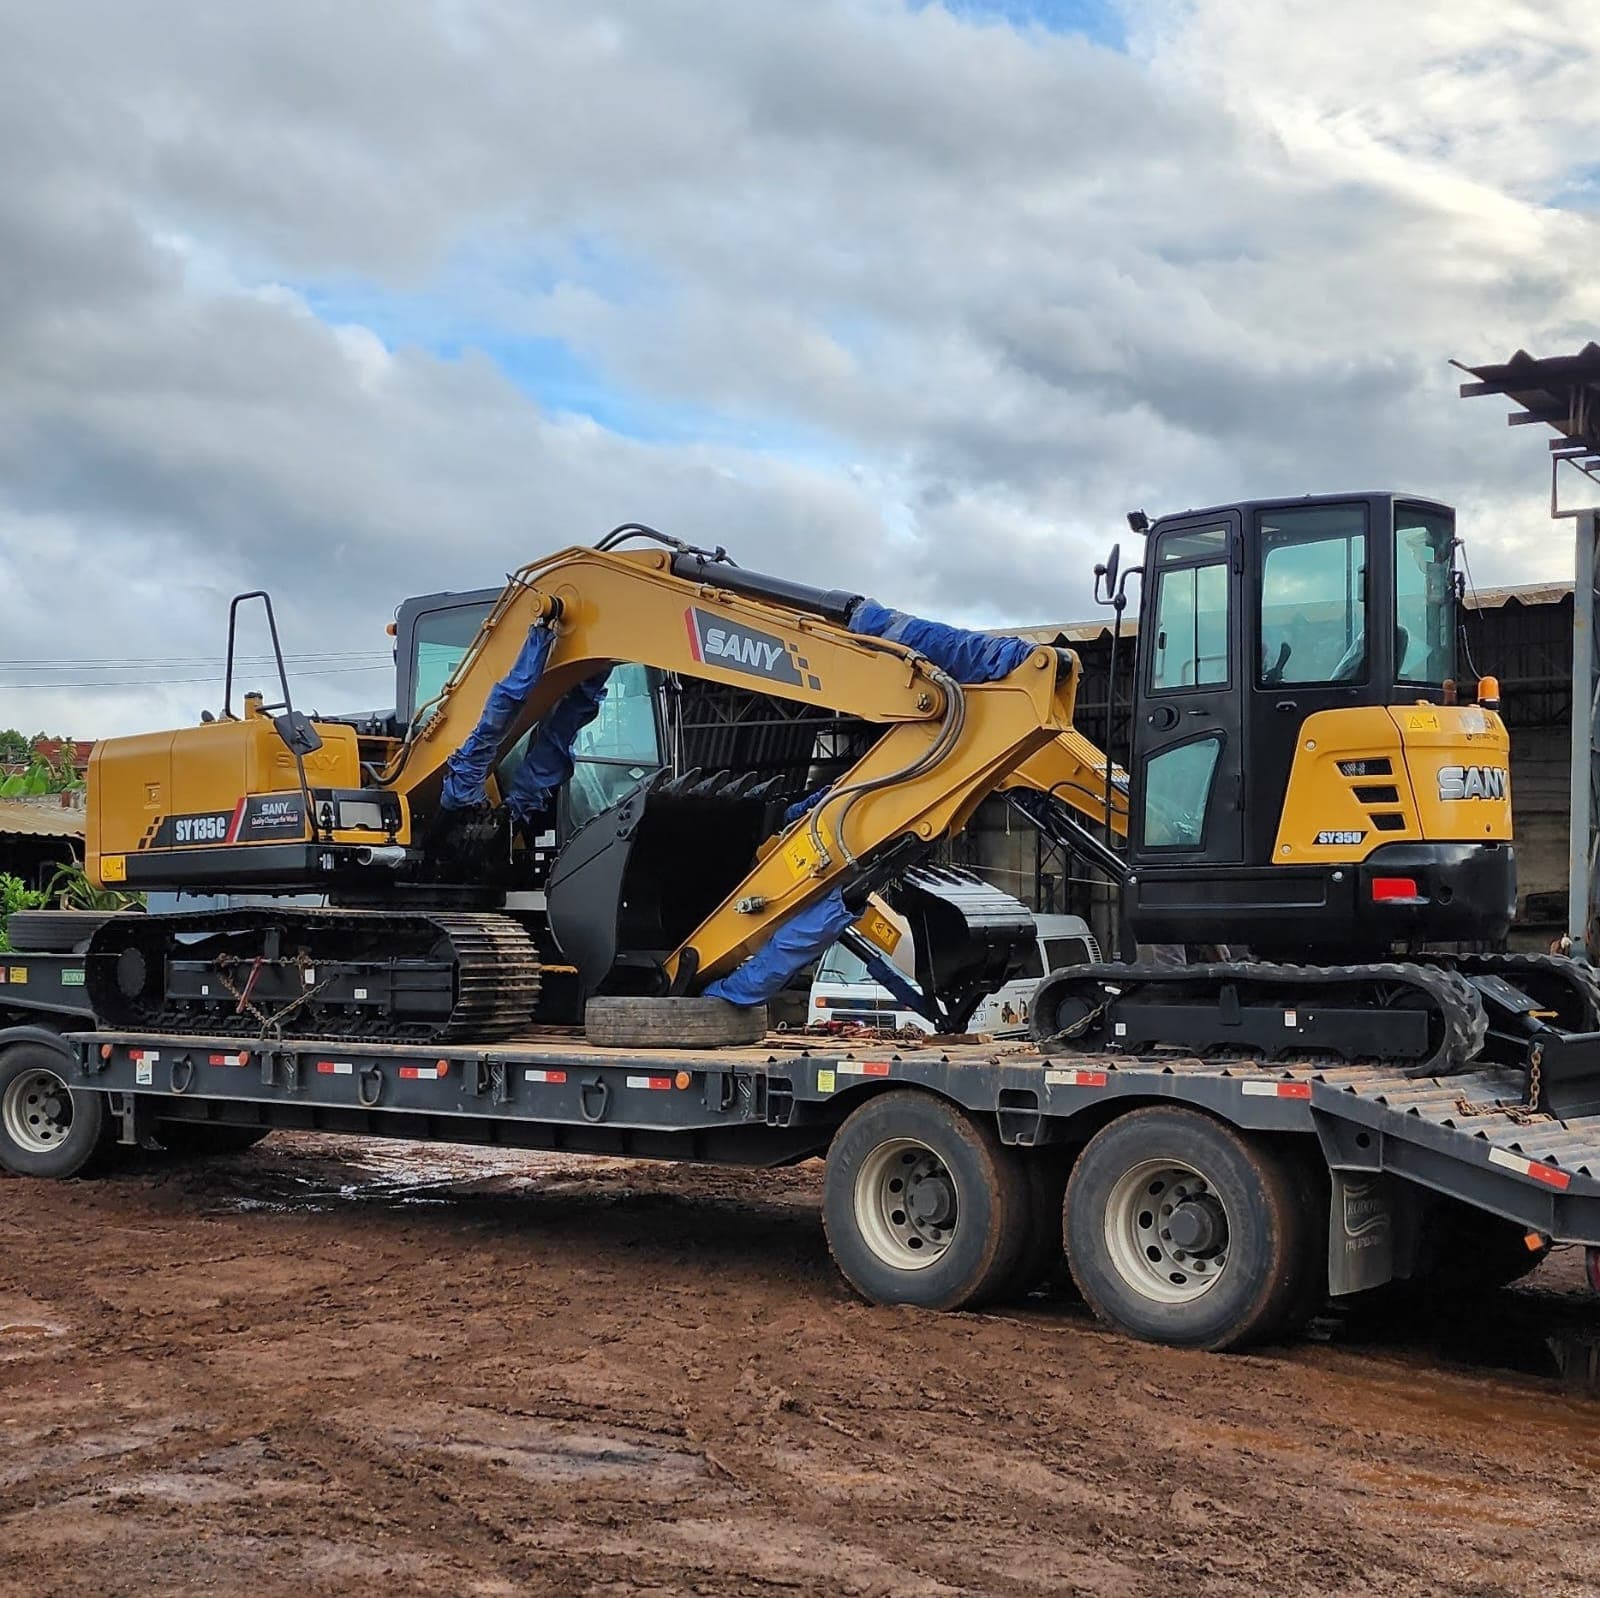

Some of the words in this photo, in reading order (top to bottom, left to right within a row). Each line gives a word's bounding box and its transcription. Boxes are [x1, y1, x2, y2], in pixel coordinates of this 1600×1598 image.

[705, 628, 783, 671] SANY
[1438, 766, 1507, 800] SANY
[261, 802, 289, 815] SANY
[176, 816, 226, 841] SY135C
[1318, 831, 1361, 844] SY35U
